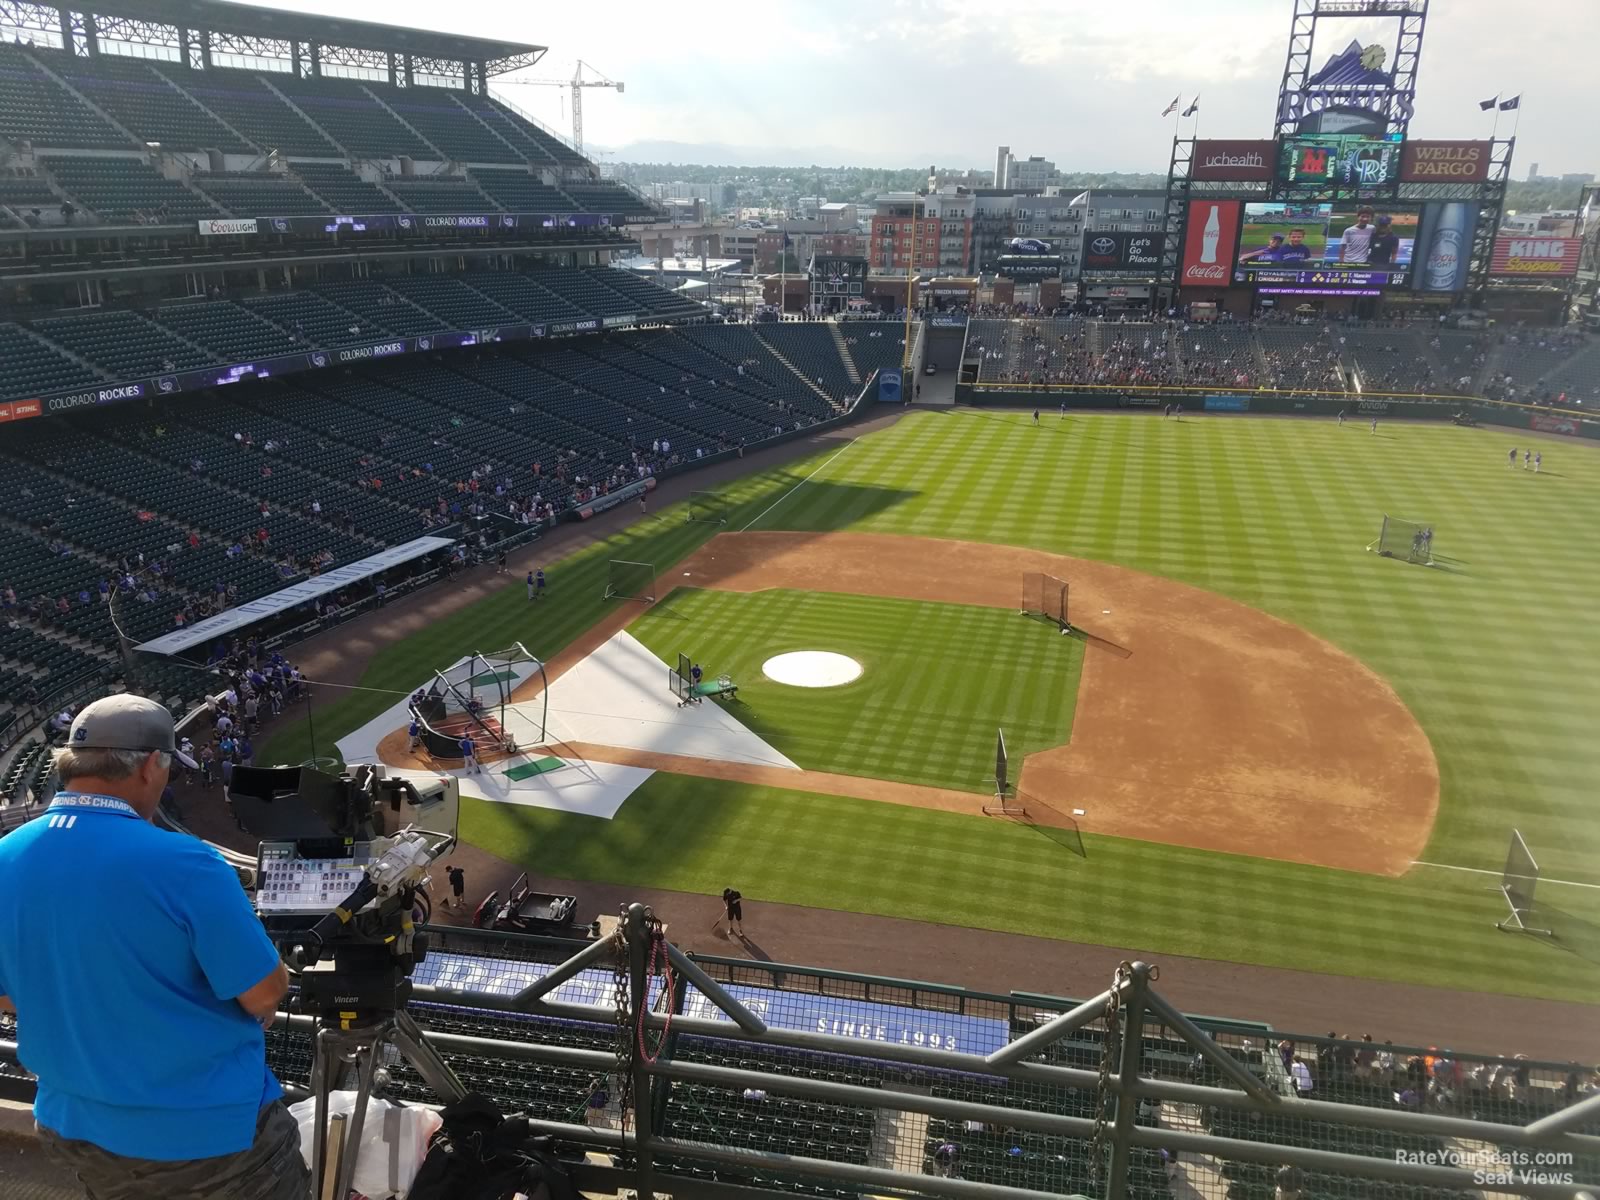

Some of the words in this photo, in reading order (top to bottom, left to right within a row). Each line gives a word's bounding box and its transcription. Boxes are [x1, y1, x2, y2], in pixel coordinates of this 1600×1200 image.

[1206, 151, 1263, 167] uchealth
[1415, 147, 1480, 161] WELLS
[1412, 162, 1477, 176] FARGO
[236, 223, 257, 233] LIGHT
[425, 216, 457, 226] COLORADO
[458, 216, 486, 226] ROCKIES
[1018, 243, 1038, 251] TOYOTA
[1130, 237, 1151, 246] Let's
[1509, 240, 1566, 257] KING
[1129, 247, 1142, 255] Go
[1129, 255, 1158, 263] Places
[1504, 256, 1564, 273] Soopers
[552, 323, 575, 333] COLORADO
[576, 320, 598, 329] ROCKIES
[340, 347, 373, 361] COLORADO
[374, 342, 401, 356] ROCKIES
[49, 393, 97, 410] COLORADO
[99, 385, 141, 402] ROCKIES
[16, 404, 38, 414] STIHL
[308, 561, 384, 587] COORS
[238, 588, 310, 614] FIELD
[817, 1017, 887, 1041] SINCE
[899, 1029, 956, 1051] 1993
